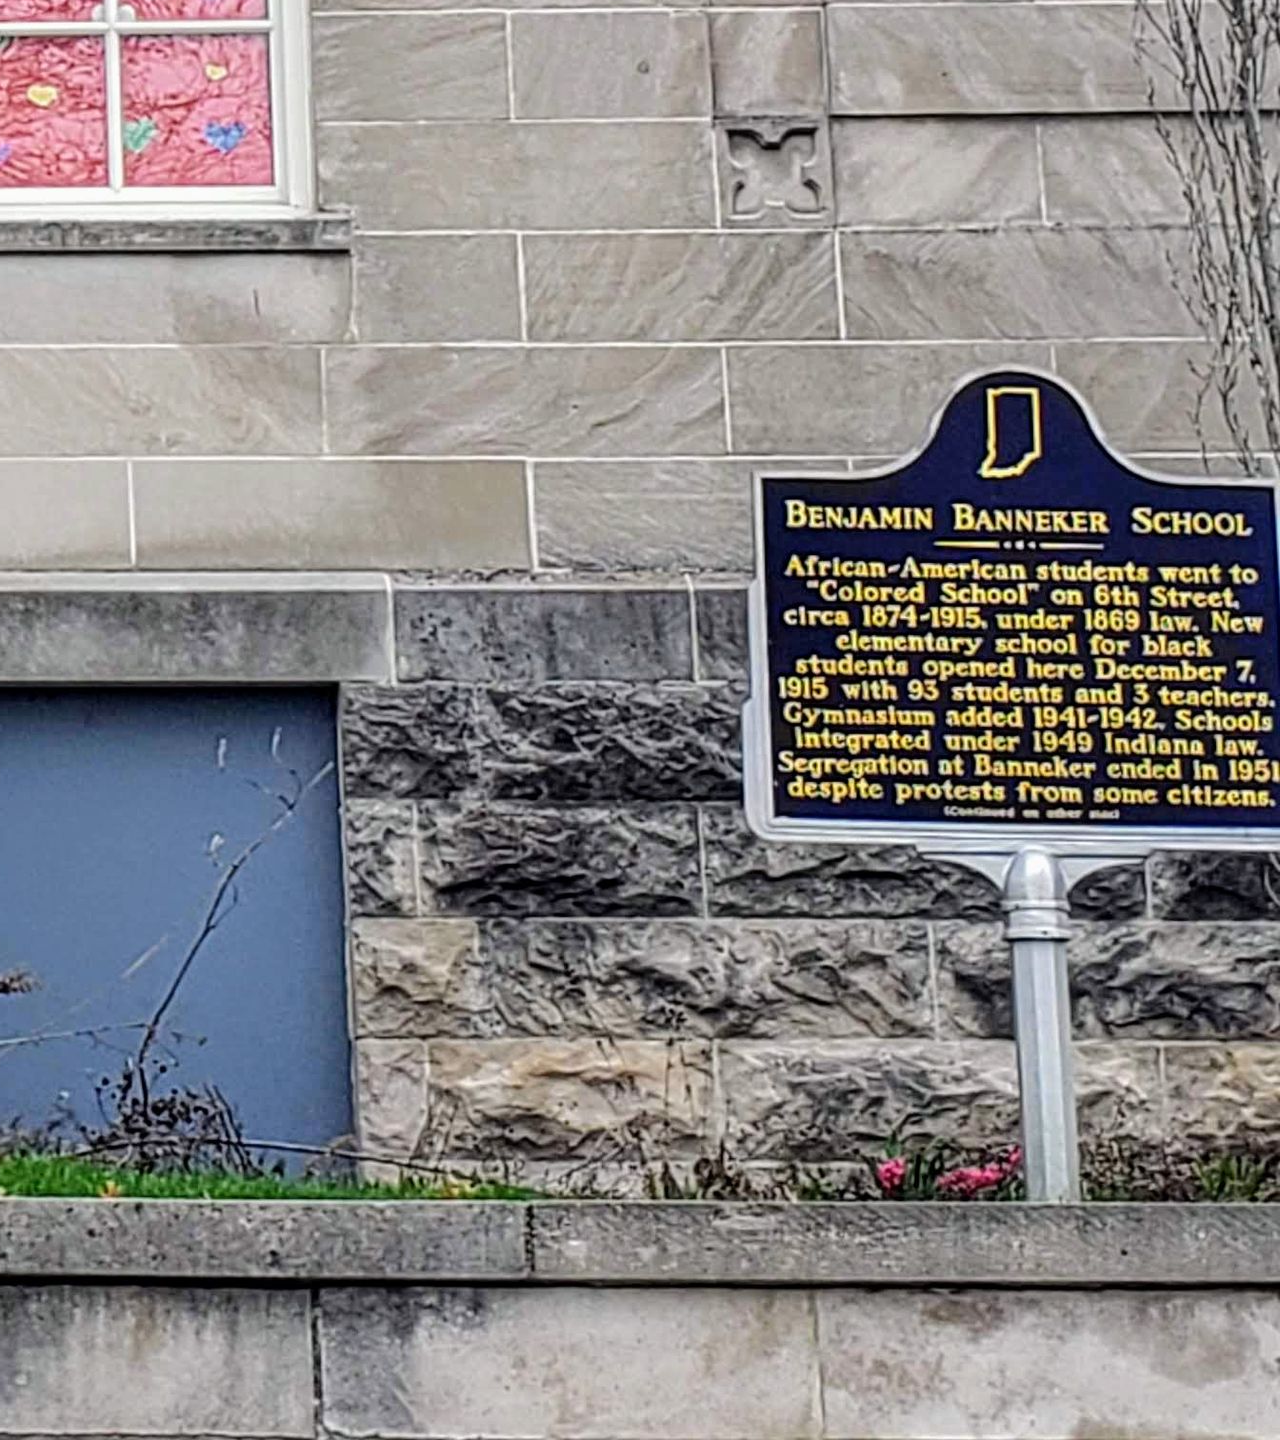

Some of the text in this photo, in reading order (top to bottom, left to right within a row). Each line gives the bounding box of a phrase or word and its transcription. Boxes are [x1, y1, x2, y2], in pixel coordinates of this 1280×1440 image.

[784, 554, 1259, 584] African-American students went to
[1050, 588, 1084, 606] on
[1094, 584, 1139, 607] 6th
[783, 606, 850, 626] circa
[996, 609, 1073, 631] under
[1084, 610, 1140, 631] 1869
[1150, 611, 1199, 632] law.
[1211, 611, 1263, 633] New
[836, 633, 1213, 657] elementary school for black
[795, 655, 909, 676] students
[922, 657, 1016, 681] opened
[1026, 658, 1084, 679] here
[1094, 658, 1227, 681] December
[778, 676, 1275, 708] 1915 with 93 students and 3 teachers.
[783, 702, 935, 727] Gymnasium
[946, 707, 1023, 727] added
[1175, 710, 1273, 731] Schools
[944, 731, 1020, 752] under
[1033, 730, 1093, 753] 1949
[1105, 732, 1205, 755] Indiana
[1214, 735, 1264, 756] law.
[778, 751, 1280, 782] Segregation at Banneker ended in 1951
[788, 776, 1276, 807] despite protests from some citizens.
